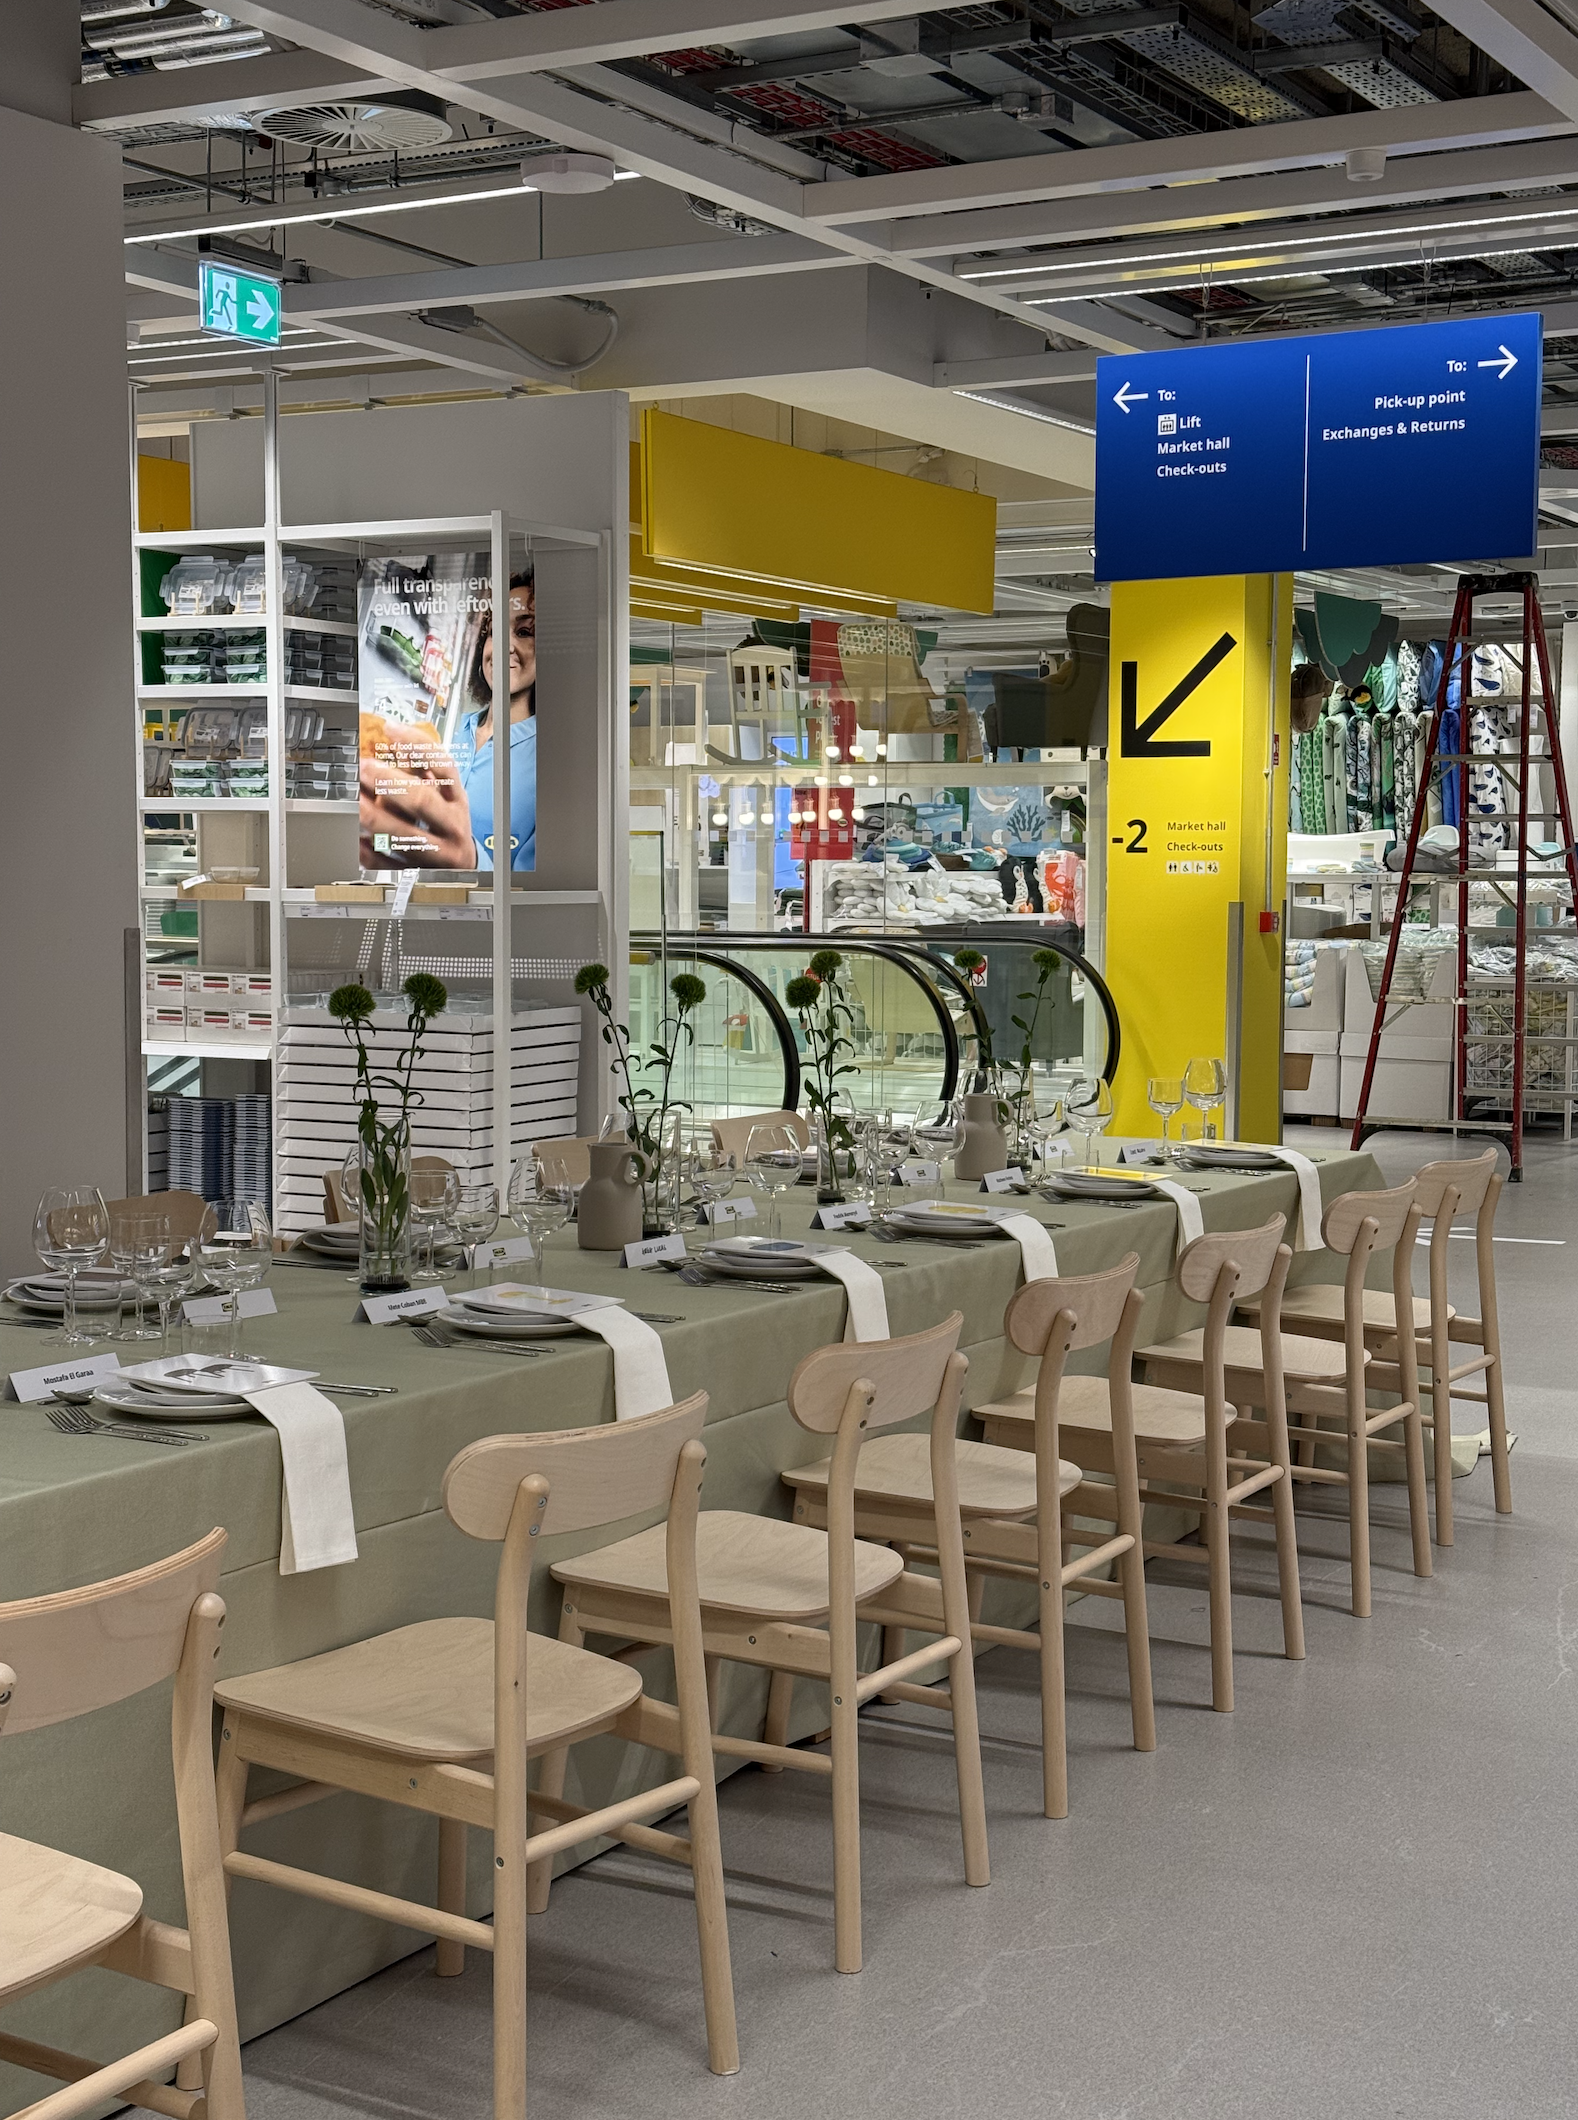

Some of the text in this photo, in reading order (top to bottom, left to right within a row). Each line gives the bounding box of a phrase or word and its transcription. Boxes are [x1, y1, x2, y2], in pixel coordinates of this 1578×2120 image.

[1447, 360, 1467, 373] To:
[1157, 390, 1176, 401] To:
[1374, 390, 1466, 411] Pick-up point
[1180, 416, 1201, 429] Lift
[1323, 417, 1466, 441] Exchanges & Returns
[1157, 437, 1231, 454] Market hall
[1157, 461, 1227, 477] Check-outs
[374, 577, 399, 595] Full
[374, 602, 410, 616] even
[414, 597, 448, 615] with
[390, 742, 397, 750] of
[397, 742, 413, 750] food
[396, 751, 408, 759] Our
[397, 760, 410, 768] less
[411, 760, 428, 770] being
[429, 760, 453, 768] thrown
[375, 778, 393, 786] Learn
[393, 778, 408, 786] how
[408, 779, 421, 788] you
[434, 778, 455, 786] create
[375, 787, 387, 795] less
[1167, 821, 1226, 831] Market hall
[1112, 819, 1148, 853] -2
[411, 844, 441, 852] everything.
[1167, 842, 1224, 852] Check-outs
[43, 1374, 69, 1385] Mostafa
[75, 1369, 94, 1379] Garaa
